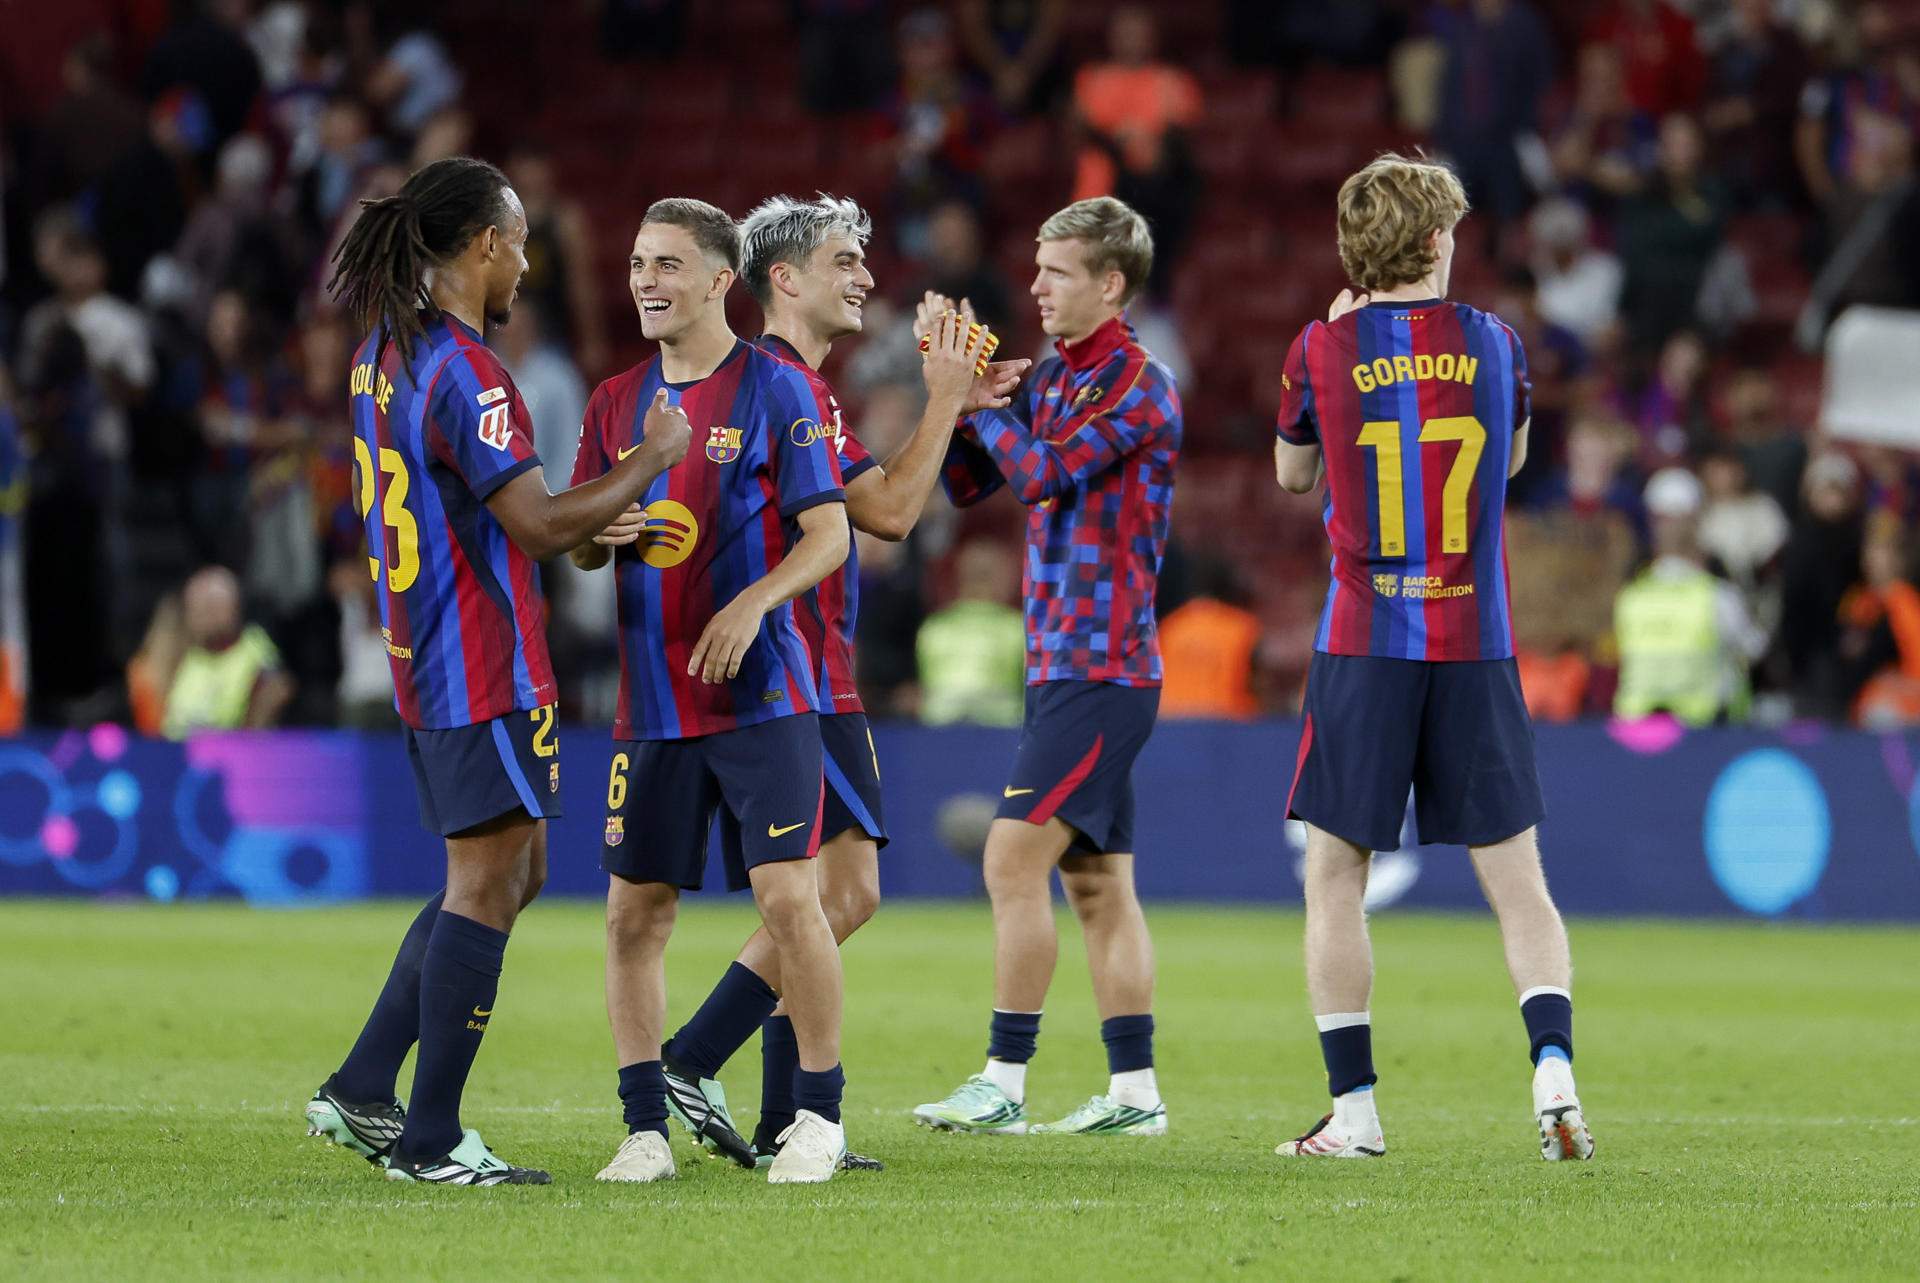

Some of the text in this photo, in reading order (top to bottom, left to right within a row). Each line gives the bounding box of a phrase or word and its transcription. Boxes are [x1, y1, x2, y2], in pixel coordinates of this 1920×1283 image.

[1352, 354, 1478, 393] GORDON
[1355, 416, 1487, 557] 17
[1402, 576, 1443, 588] BARÇA
[1402, 584, 1473, 599] FOUNDATION
[530, 701, 559, 758] 2
[607, 752, 629, 810] 6
